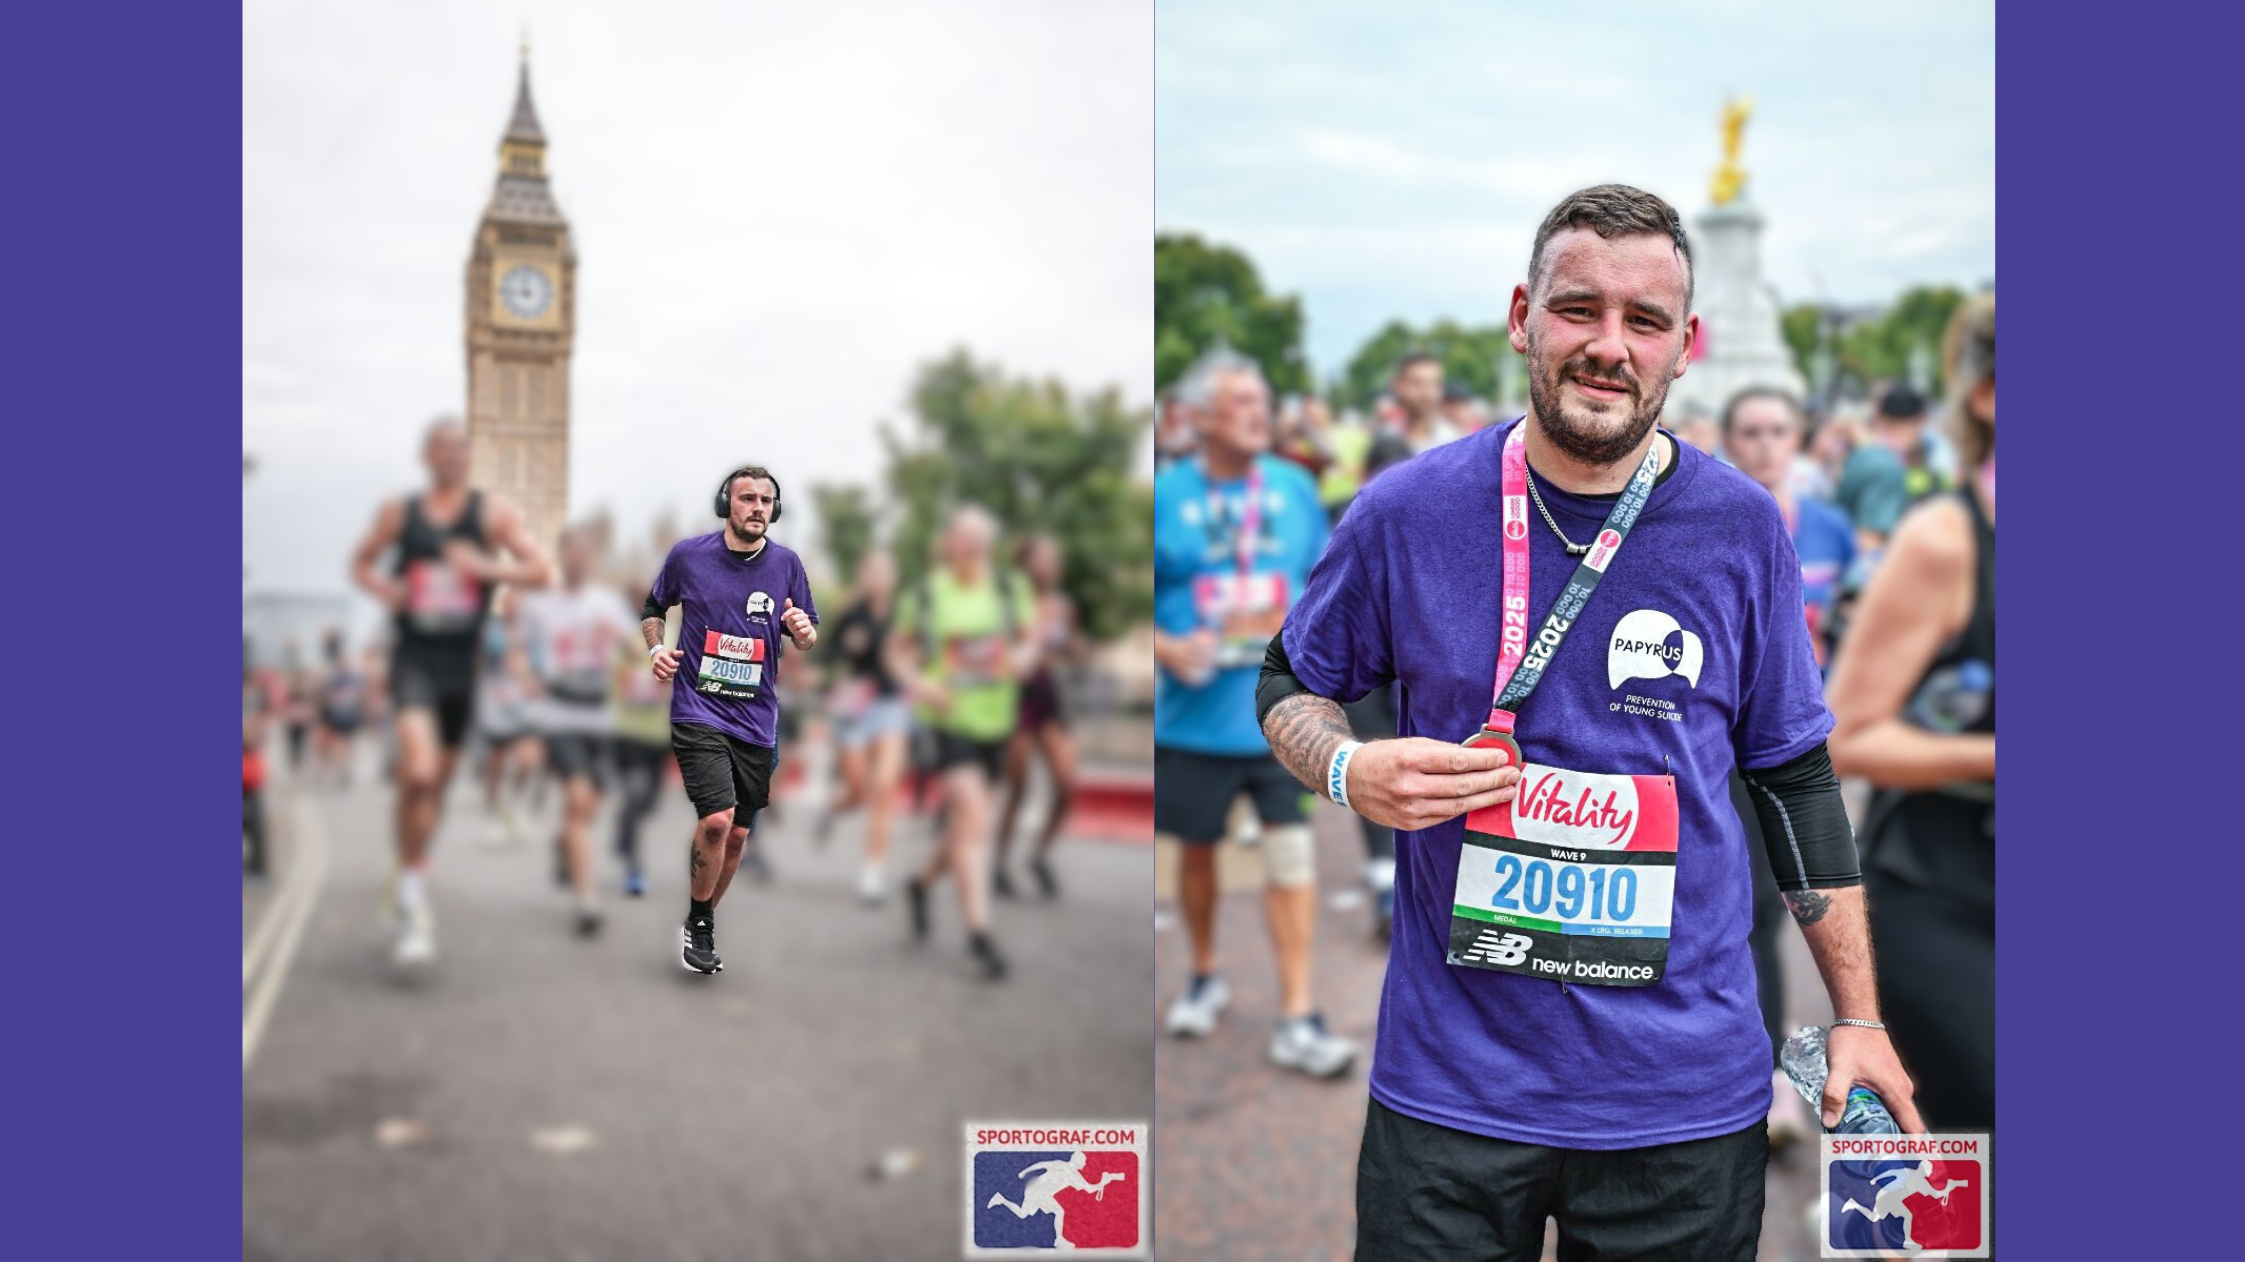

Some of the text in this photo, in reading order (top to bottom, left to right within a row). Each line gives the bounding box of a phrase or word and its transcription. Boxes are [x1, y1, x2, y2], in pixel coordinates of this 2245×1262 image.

[1503, 595, 1526, 657] 2025
[719, 637, 753, 658] Vitality
[1523, 614, 1570, 672] 2025
[1615, 638, 1682, 661] PAPYRUS
[711, 660, 752, 680] 20910
[1609, 702, 1622, 712] OF
[1624, 704, 1655, 717] YOUNG
[1626, 695, 1675, 710] PREVENTION
[1331, 750, 1348, 801] WAVE
[1516, 771, 1634, 846] Vitality
[1550, 848, 1588, 862] WAVE 9
[1491, 854, 1638, 923] 20910
[1493, 913, 1518, 925] MEDAL
[1613, 927, 1643, 935] RELAXED
[1531, 957, 1654, 981] new balance
